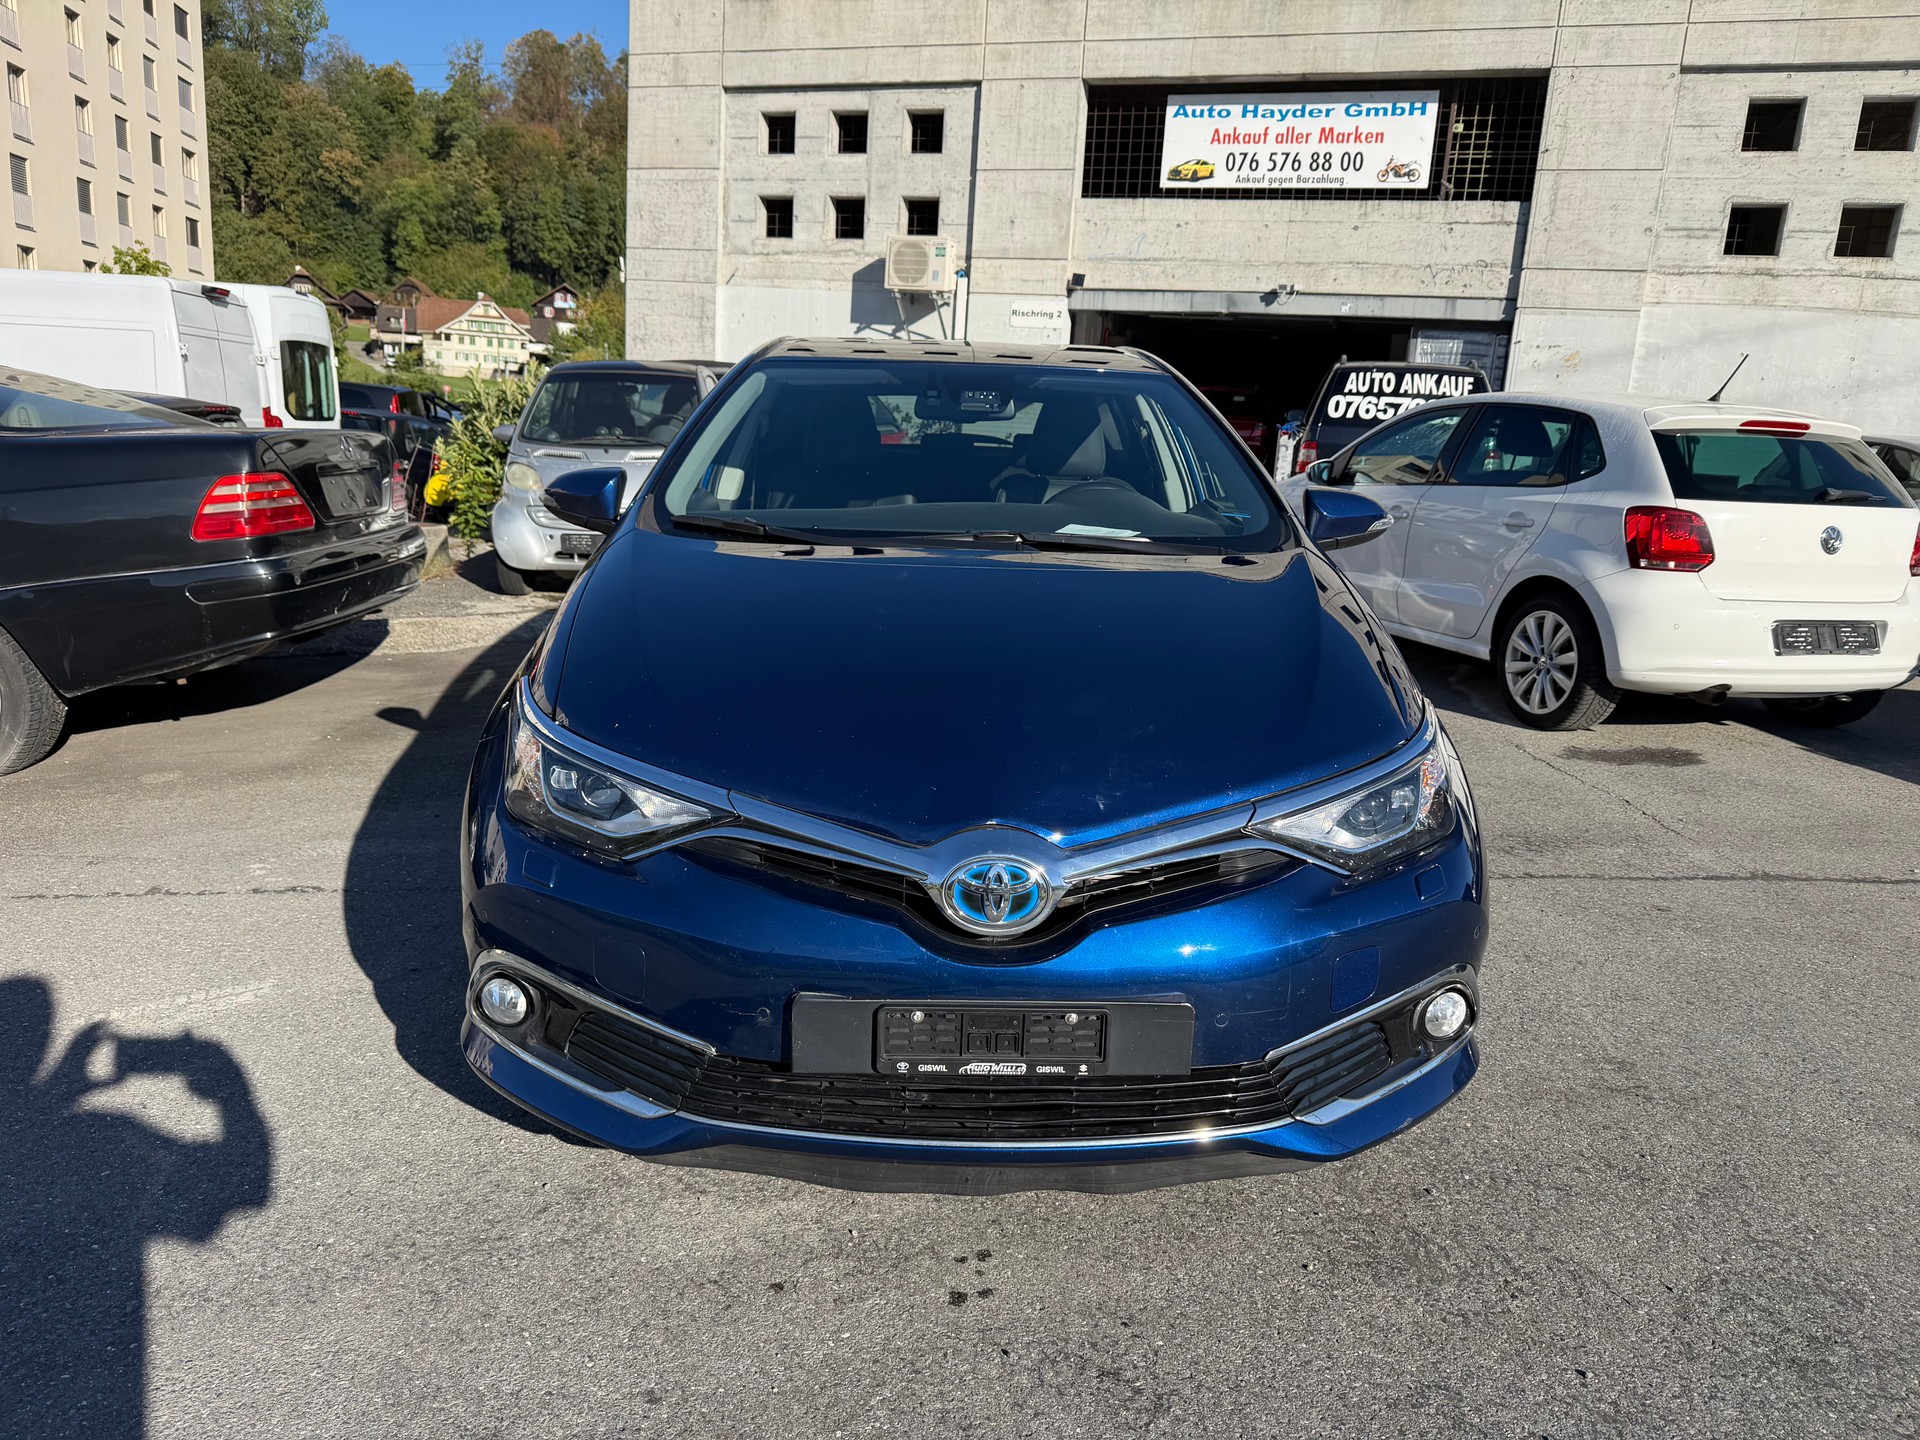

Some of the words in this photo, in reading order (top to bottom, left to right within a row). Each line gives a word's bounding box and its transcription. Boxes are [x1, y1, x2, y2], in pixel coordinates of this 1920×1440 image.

[1172, 104, 1232, 119] Auto
[1241, 104, 1336, 122] Hayder
[1344, 102, 1428, 118] GmbH
[1210, 126, 1270, 145] Ankauf
[1275, 126, 1313, 145] aller
[1318, 125, 1385, 144] Marken
[1225, 152, 1259, 172] 076
[1267, 151, 1301, 172] 576
[1309, 151, 1333, 172] 88
[1340, 151, 1364, 172] 00
[1235, 174, 1266, 184] Ankauf
[1268, 176, 1293, 187] gegen
[1296, 174, 1345, 186] Barzahlung
[1011, 309, 1054, 319] Rischring
[1344, 371, 1396, 394] AUTO
[1399, 373, 1474, 397] ANKAUF
[918, 1064, 948, 1072] GISWIL
[1036, 1066, 1066, 1074] GISWIL
